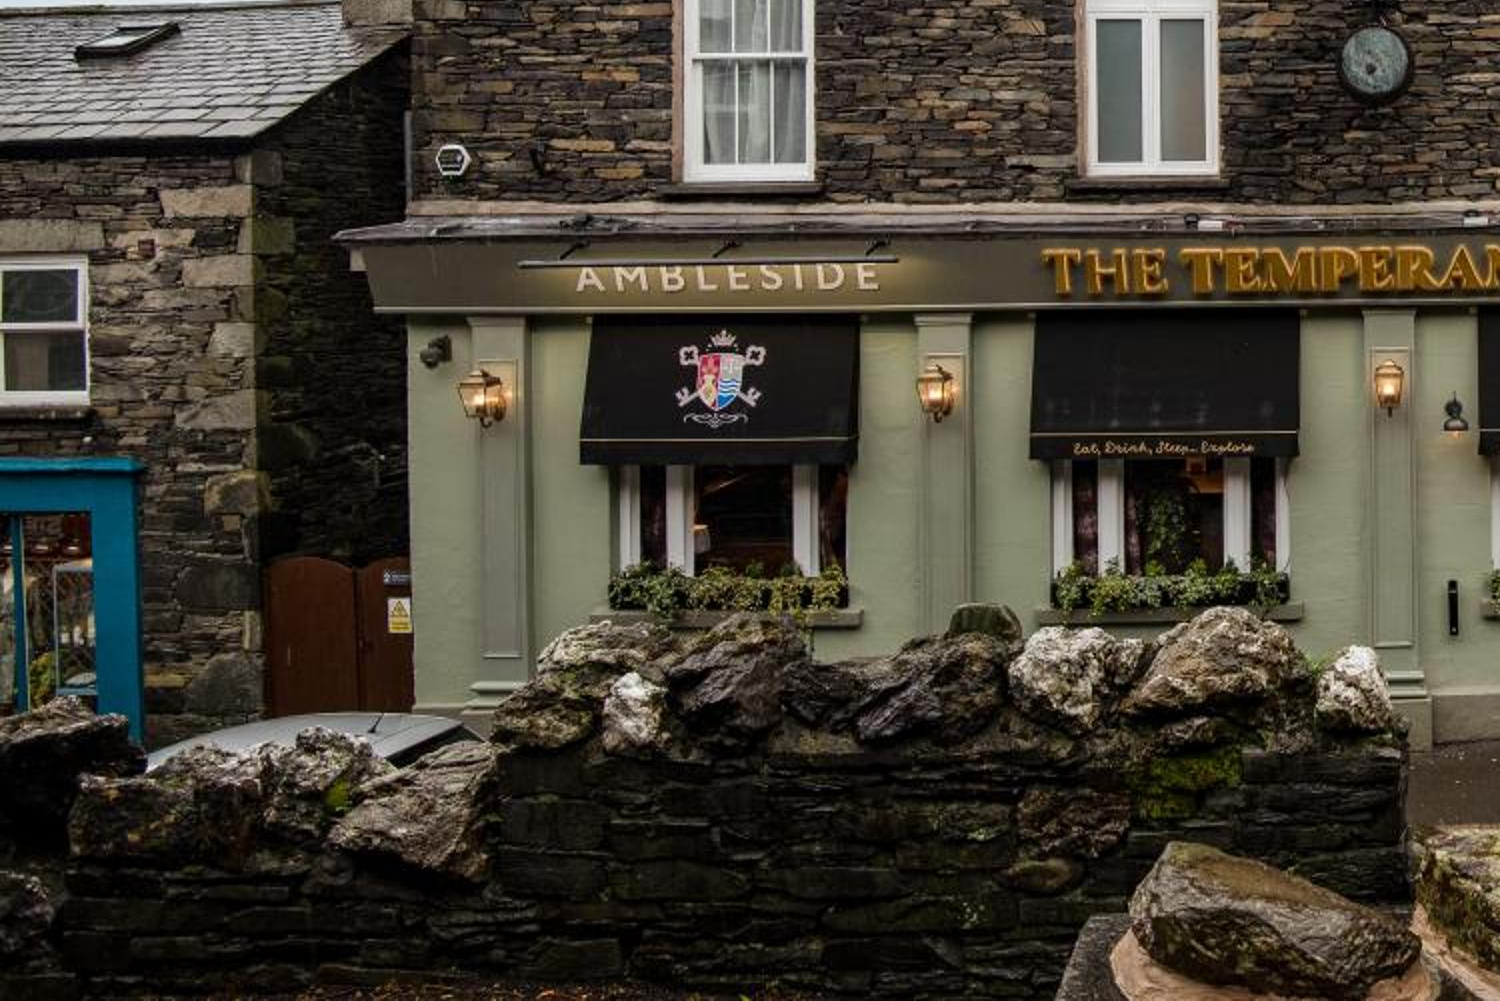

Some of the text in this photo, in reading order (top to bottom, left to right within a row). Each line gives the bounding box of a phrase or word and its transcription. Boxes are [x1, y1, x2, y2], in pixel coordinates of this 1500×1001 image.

[575, 262, 881, 293] AMBLESIDE
[1041, 246, 1169, 295] THE
[1200, 440, 1255, 456] Explore
